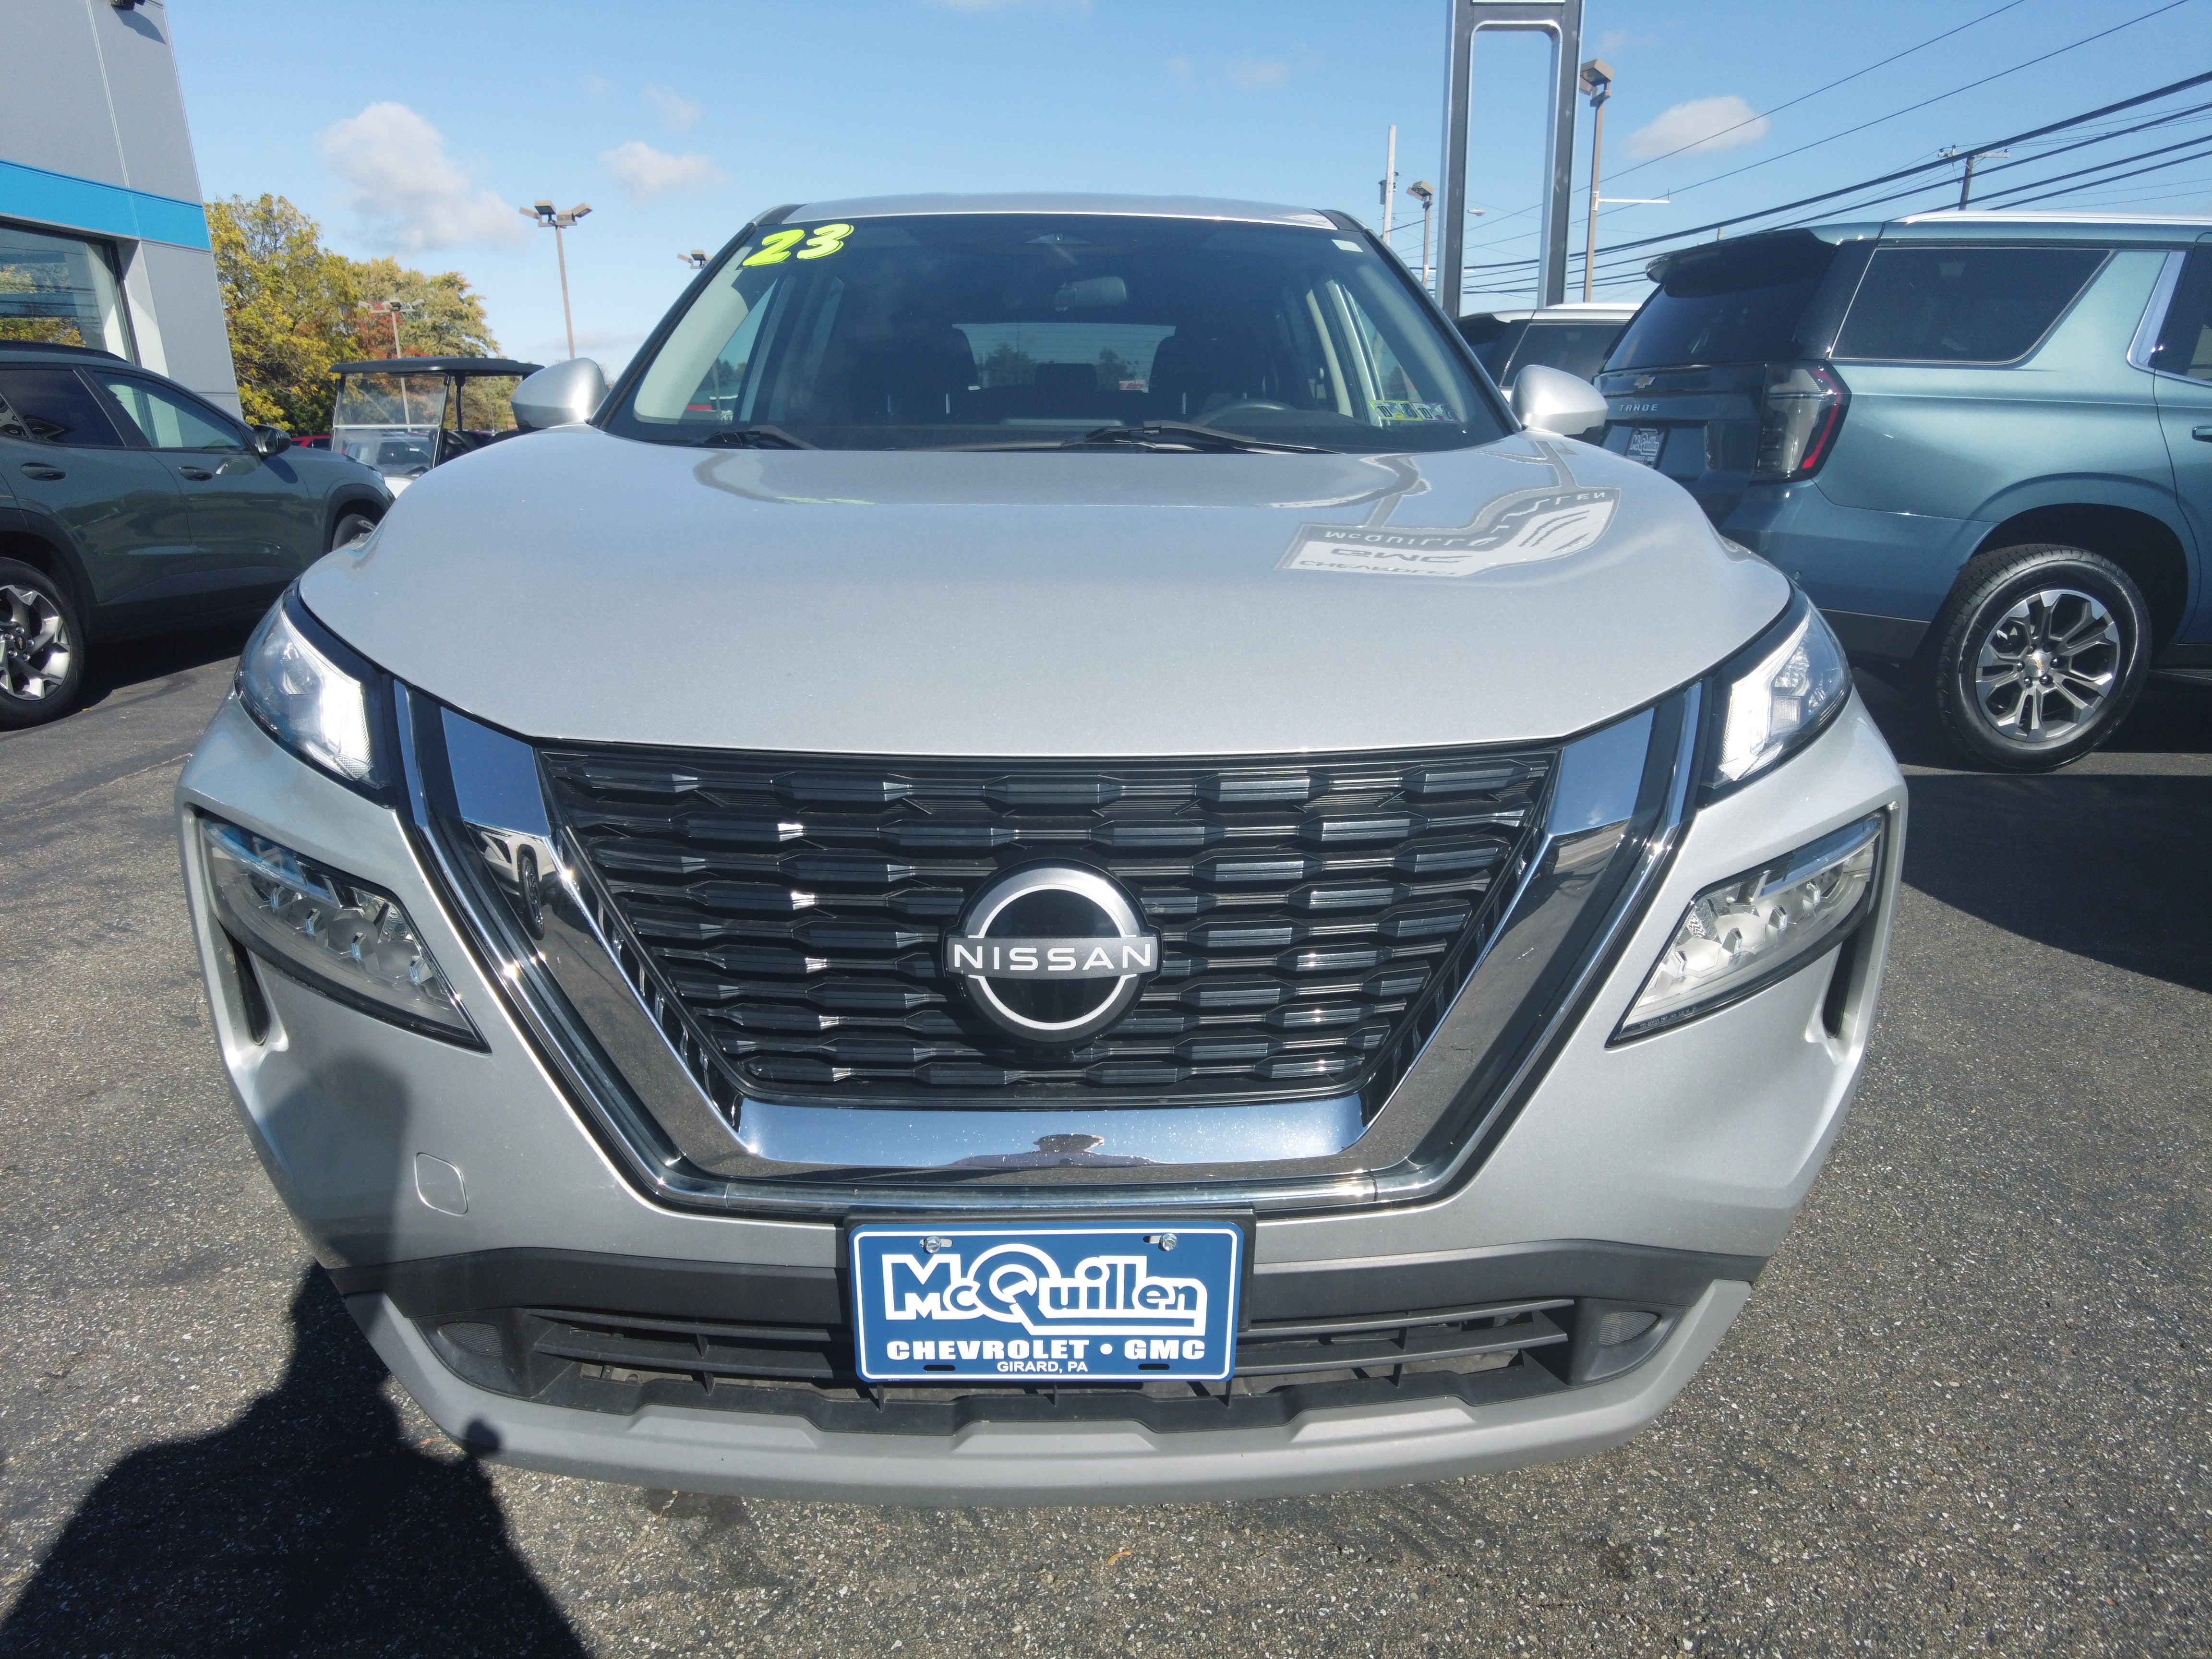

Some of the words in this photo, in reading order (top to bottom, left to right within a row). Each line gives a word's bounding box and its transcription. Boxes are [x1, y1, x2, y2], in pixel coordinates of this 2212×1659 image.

[742, 223, 854, 267] 23
[1619, 404, 1659, 412] TAHOE
[954, 943, 1151, 971] NISSAN
[881, 1243, 1208, 1336] McQuillen
[887, 1339, 1090, 1359] CHEVROLET
[1124, 1339, 1205, 1359] GMC
[997, 1361, 1062, 1373] GIRARD,
[1068, 1361, 1088, 1372] PA
